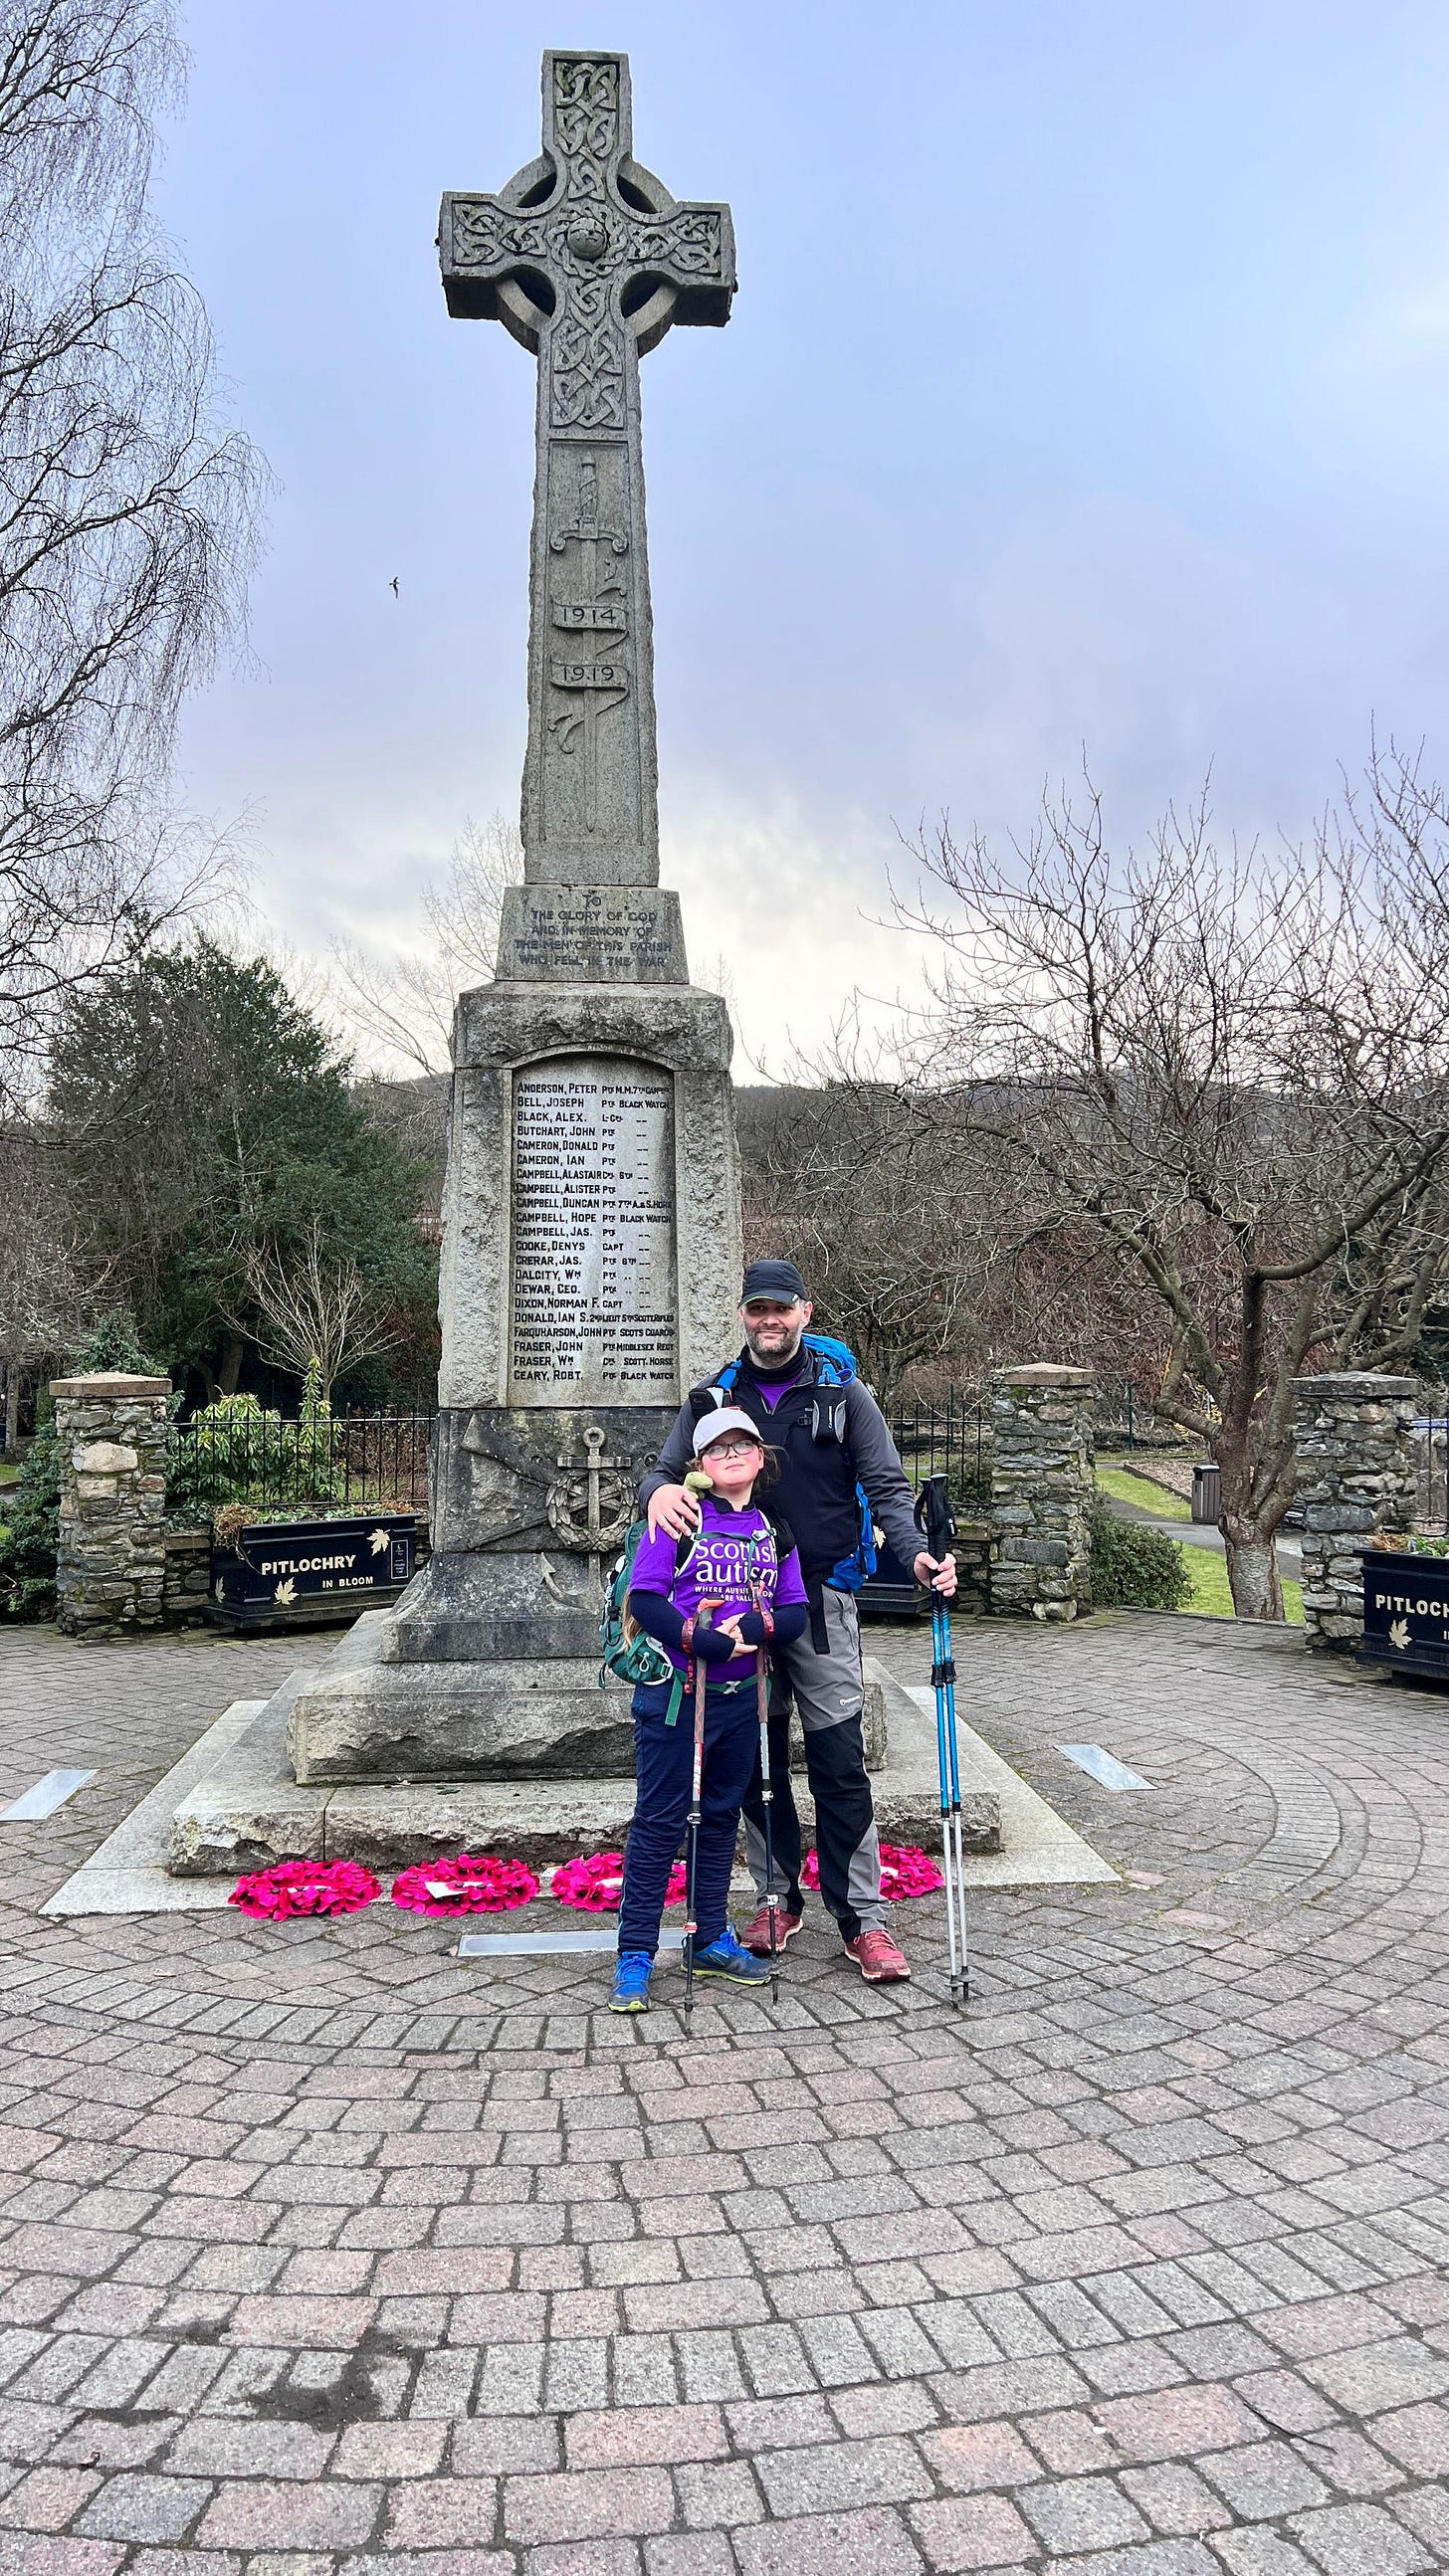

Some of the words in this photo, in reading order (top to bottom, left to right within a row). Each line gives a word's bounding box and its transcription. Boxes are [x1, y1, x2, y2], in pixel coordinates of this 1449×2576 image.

[563, 607, 616, 624] 1914
[563, 667, 614, 682] 1919
[582, 894, 602, 907] TO
[531, 909, 553, 920] THE
[558, 910, 601, 921] GLORY
[607, 911, 623, 921] OF
[627, 911, 658, 921] GOD
[579, 925, 630, 936] MEMORY
[630, 941, 673, 952] PARISH
[518, 1083, 567, 1094] ANDERSON,
[568, 1083, 597, 1093] PETER
[518, 1096, 545, 1108] BELL,
[546, 1097, 584, 1107] JOSEPH
[619, 1099, 644, 1108] BLACK
[518, 1111, 553, 1123] BLACK,
[555, 1112, 587, 1122] ALEX.
[518, 1125, 567, 1137] BUTCHART,
[569, 1126, 596, 1136] JOHN
[518, 1139, 561, 1152] CAMERON,
[562, 1140, 598, 1150] DONALD
[518, 1153, 563, 1166] CAMERON,
[566, 1154, 585, 1165] IAN
[517, 1168, 562, 1180] CAMPBELL,
[562, 1169, 601, 1179] ALASTAIR
[517, 1183, 563, 1195] CAMPBELL,
[564, 1183, 600, 1194] ALISTER
[517, 1197, 562, 1209] CAMPBELL,
[563, 1197, 600, 1208] DUNCAN
[517, 1212, 568, 1224] CAMPBELL,
[571, 1212, 596, 1223] HOPE
[620, 1214, 645, 1223] BLACK
[646, 1214, 672, 1223] WATCH
[517, 1226, 569, 1238] CAMPBELL,
[570, 1227, 592, 1237] JAS.
[516, 1241, 550, 1253] COOKE,
[551, 1241, 585, 1251] DENYS
[516, 1255, 557, 1267] CRERAR,
[559, 1255, 582, 1266] JAS.
[516, 1284, 554, 1295] DEWAR,
[515, 1297, 547, 1309] DIXON,
[547, 1297, 588, 1308] NORMAN
[592, 1296, 600, 1308] F.
[515, 1312, 557, 1324] DONALD,
[558, 1312, 575, 1322] IAN
[579, 1312, 589, 1322] S.
[514, 1326, 578, 1338] FARQUHARSON,
[578, 1326, 602, 1337] JOHN
[620, 1328, 644, 1337] SCOTS
[514, 1340, 554, 1353] FRASER,
[555, 1340, 583, 1351] JOHN
[514, 1355, 554, 1367] FRASER,
[649, 1357, 674, 1366] HORSE
[553, 1370, 583, 1380] ROBT.
[621, 1371, 647, 1380] BLACK
[650, 1371, 675, 1380] WATCH
[262, 1555, 356, 1576] PITLOCHRY
[696, 1560, 777, 1589] autism
[322, 1579, 333, 1589] IN
[339, 1576, 373, 1587] BLOOM
